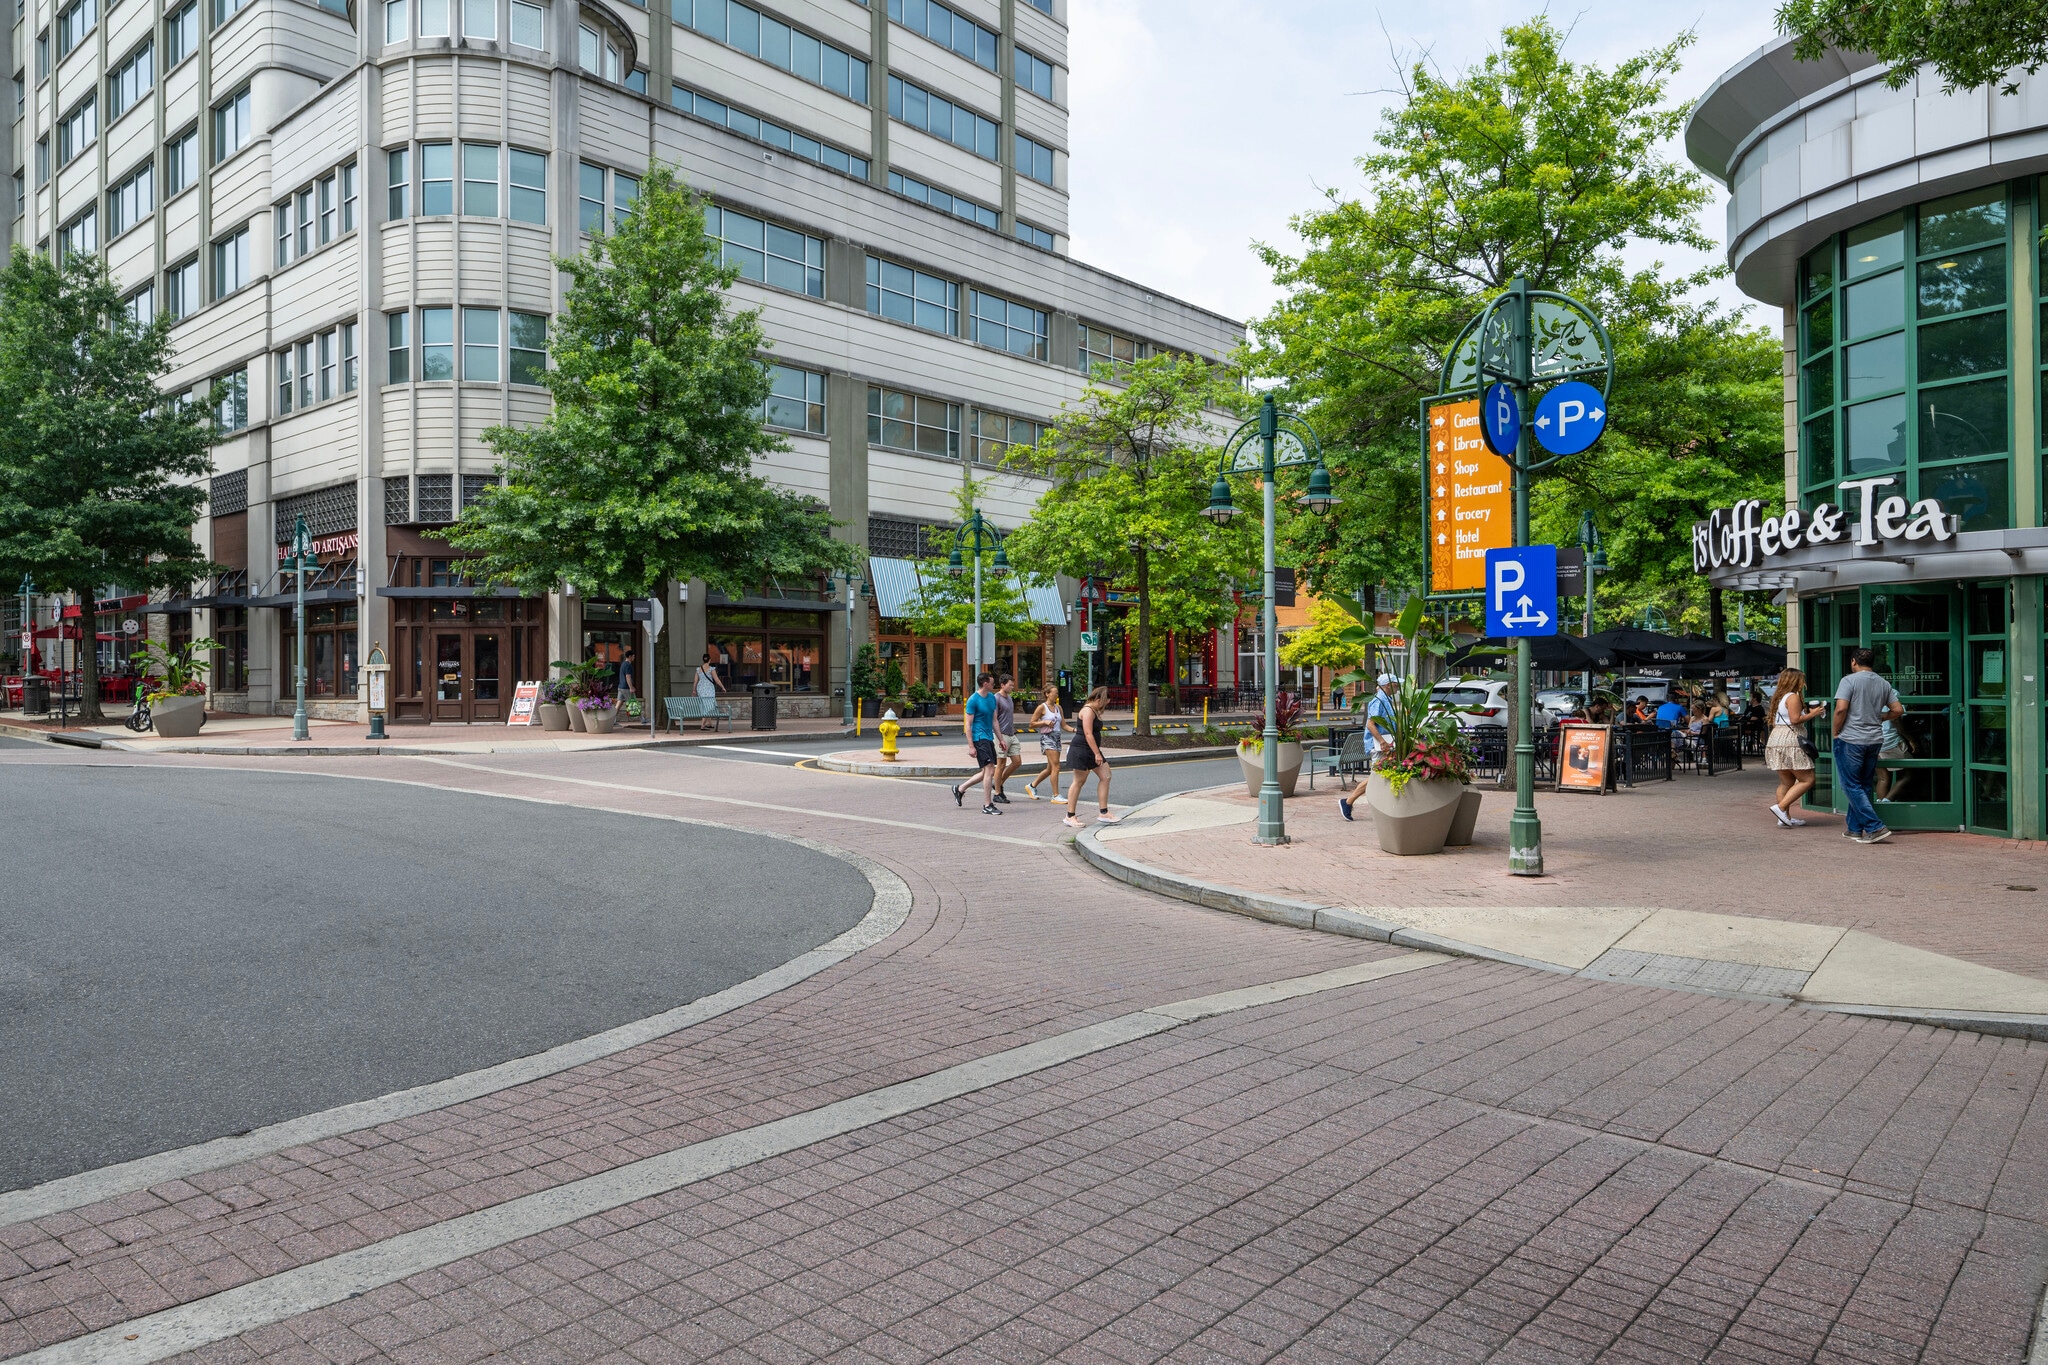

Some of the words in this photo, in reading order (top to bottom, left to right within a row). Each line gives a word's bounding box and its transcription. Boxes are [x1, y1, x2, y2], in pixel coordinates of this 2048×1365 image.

[1454, 413, 1480, 428] Cinem
[1498, 401, 1511, 436] P
[1559, 400, 1585, 437] P
[1454, 435, 1485, 451] Library
[1454, 460, 1479, 477] Shops
[1454, 480, 1503, 498] Restaurant
[1455, 506, 1491, 522] Grocery
[1708, 500, 1801, 568] Coffee
[1806, 503, 1844, 543] &
[1838, 478, 1951, 546] Tea
[321, 533, 358, 556] ARTISANS
[1456, 527, 1480, 544] Hotel
[1495, 560, 1526, 611] P
